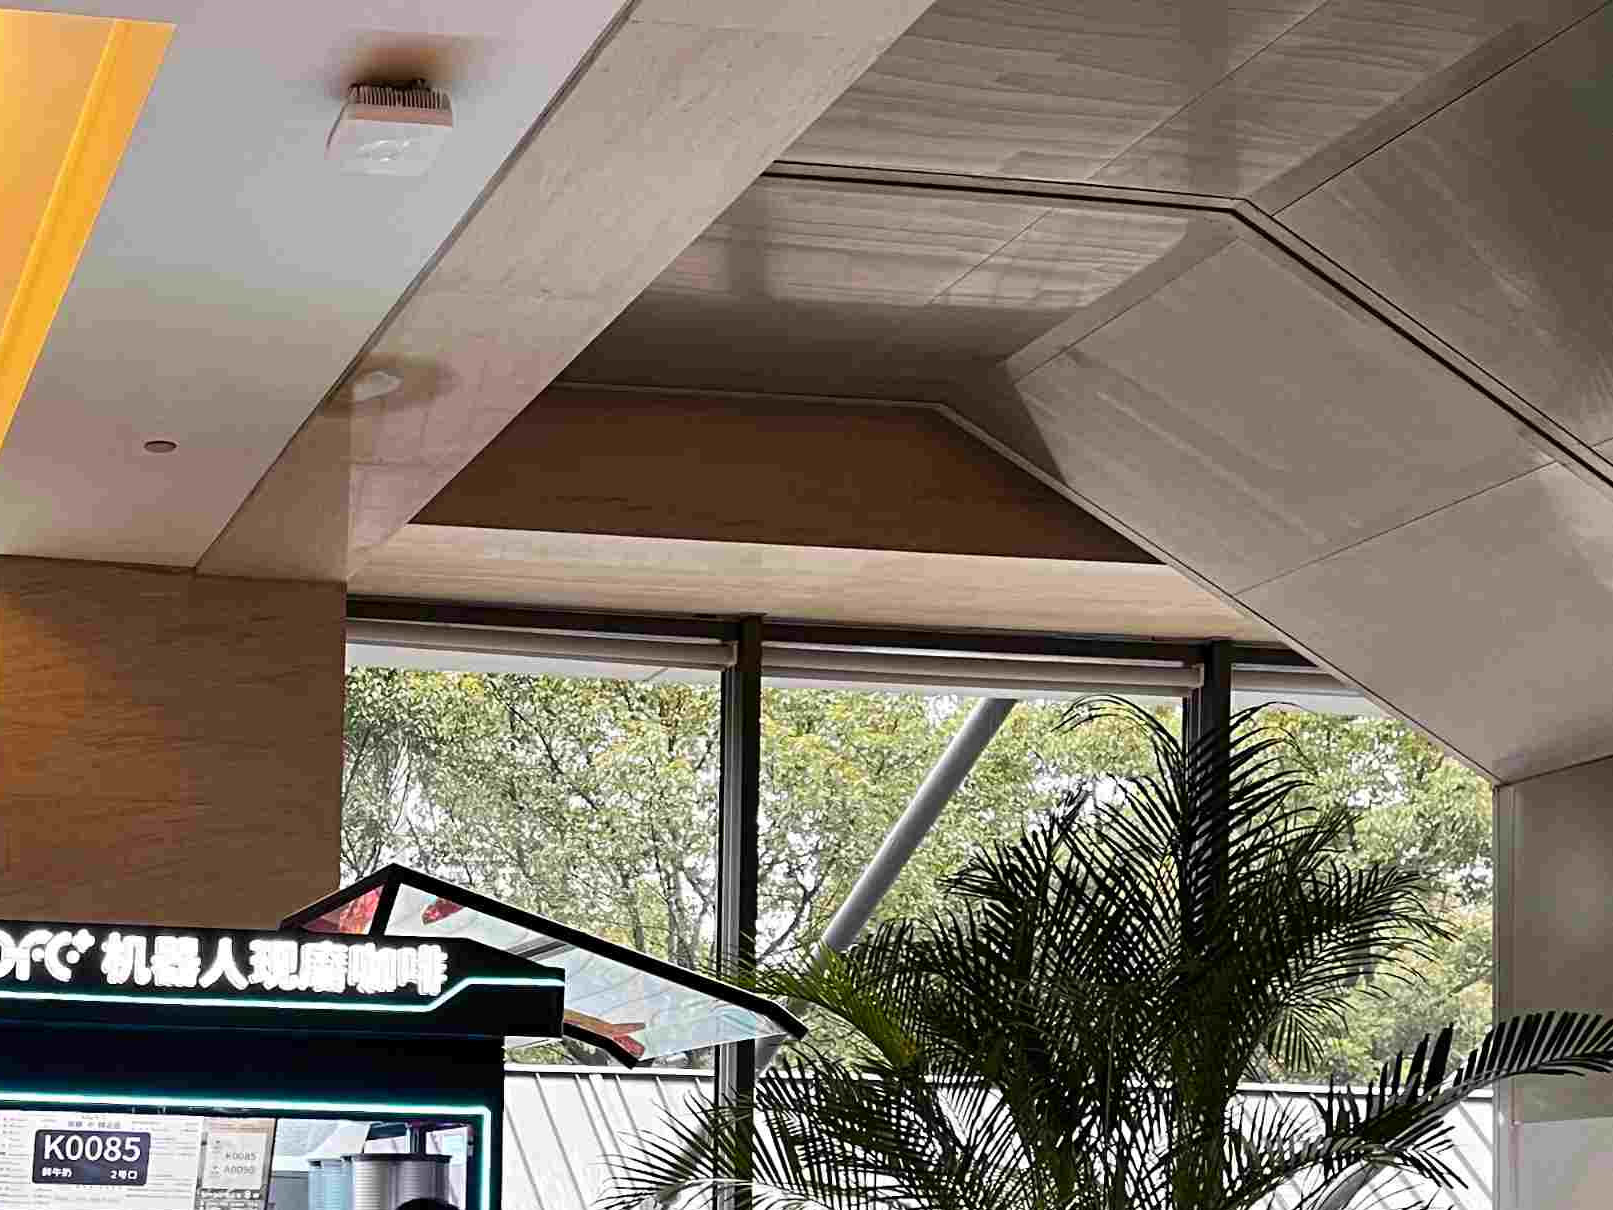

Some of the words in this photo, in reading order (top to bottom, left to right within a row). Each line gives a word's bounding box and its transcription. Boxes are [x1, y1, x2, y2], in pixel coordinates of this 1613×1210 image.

[100, 931, 448, 996] 机器人现磨咖啡
[43, 1134, 141, 1162] K0085
